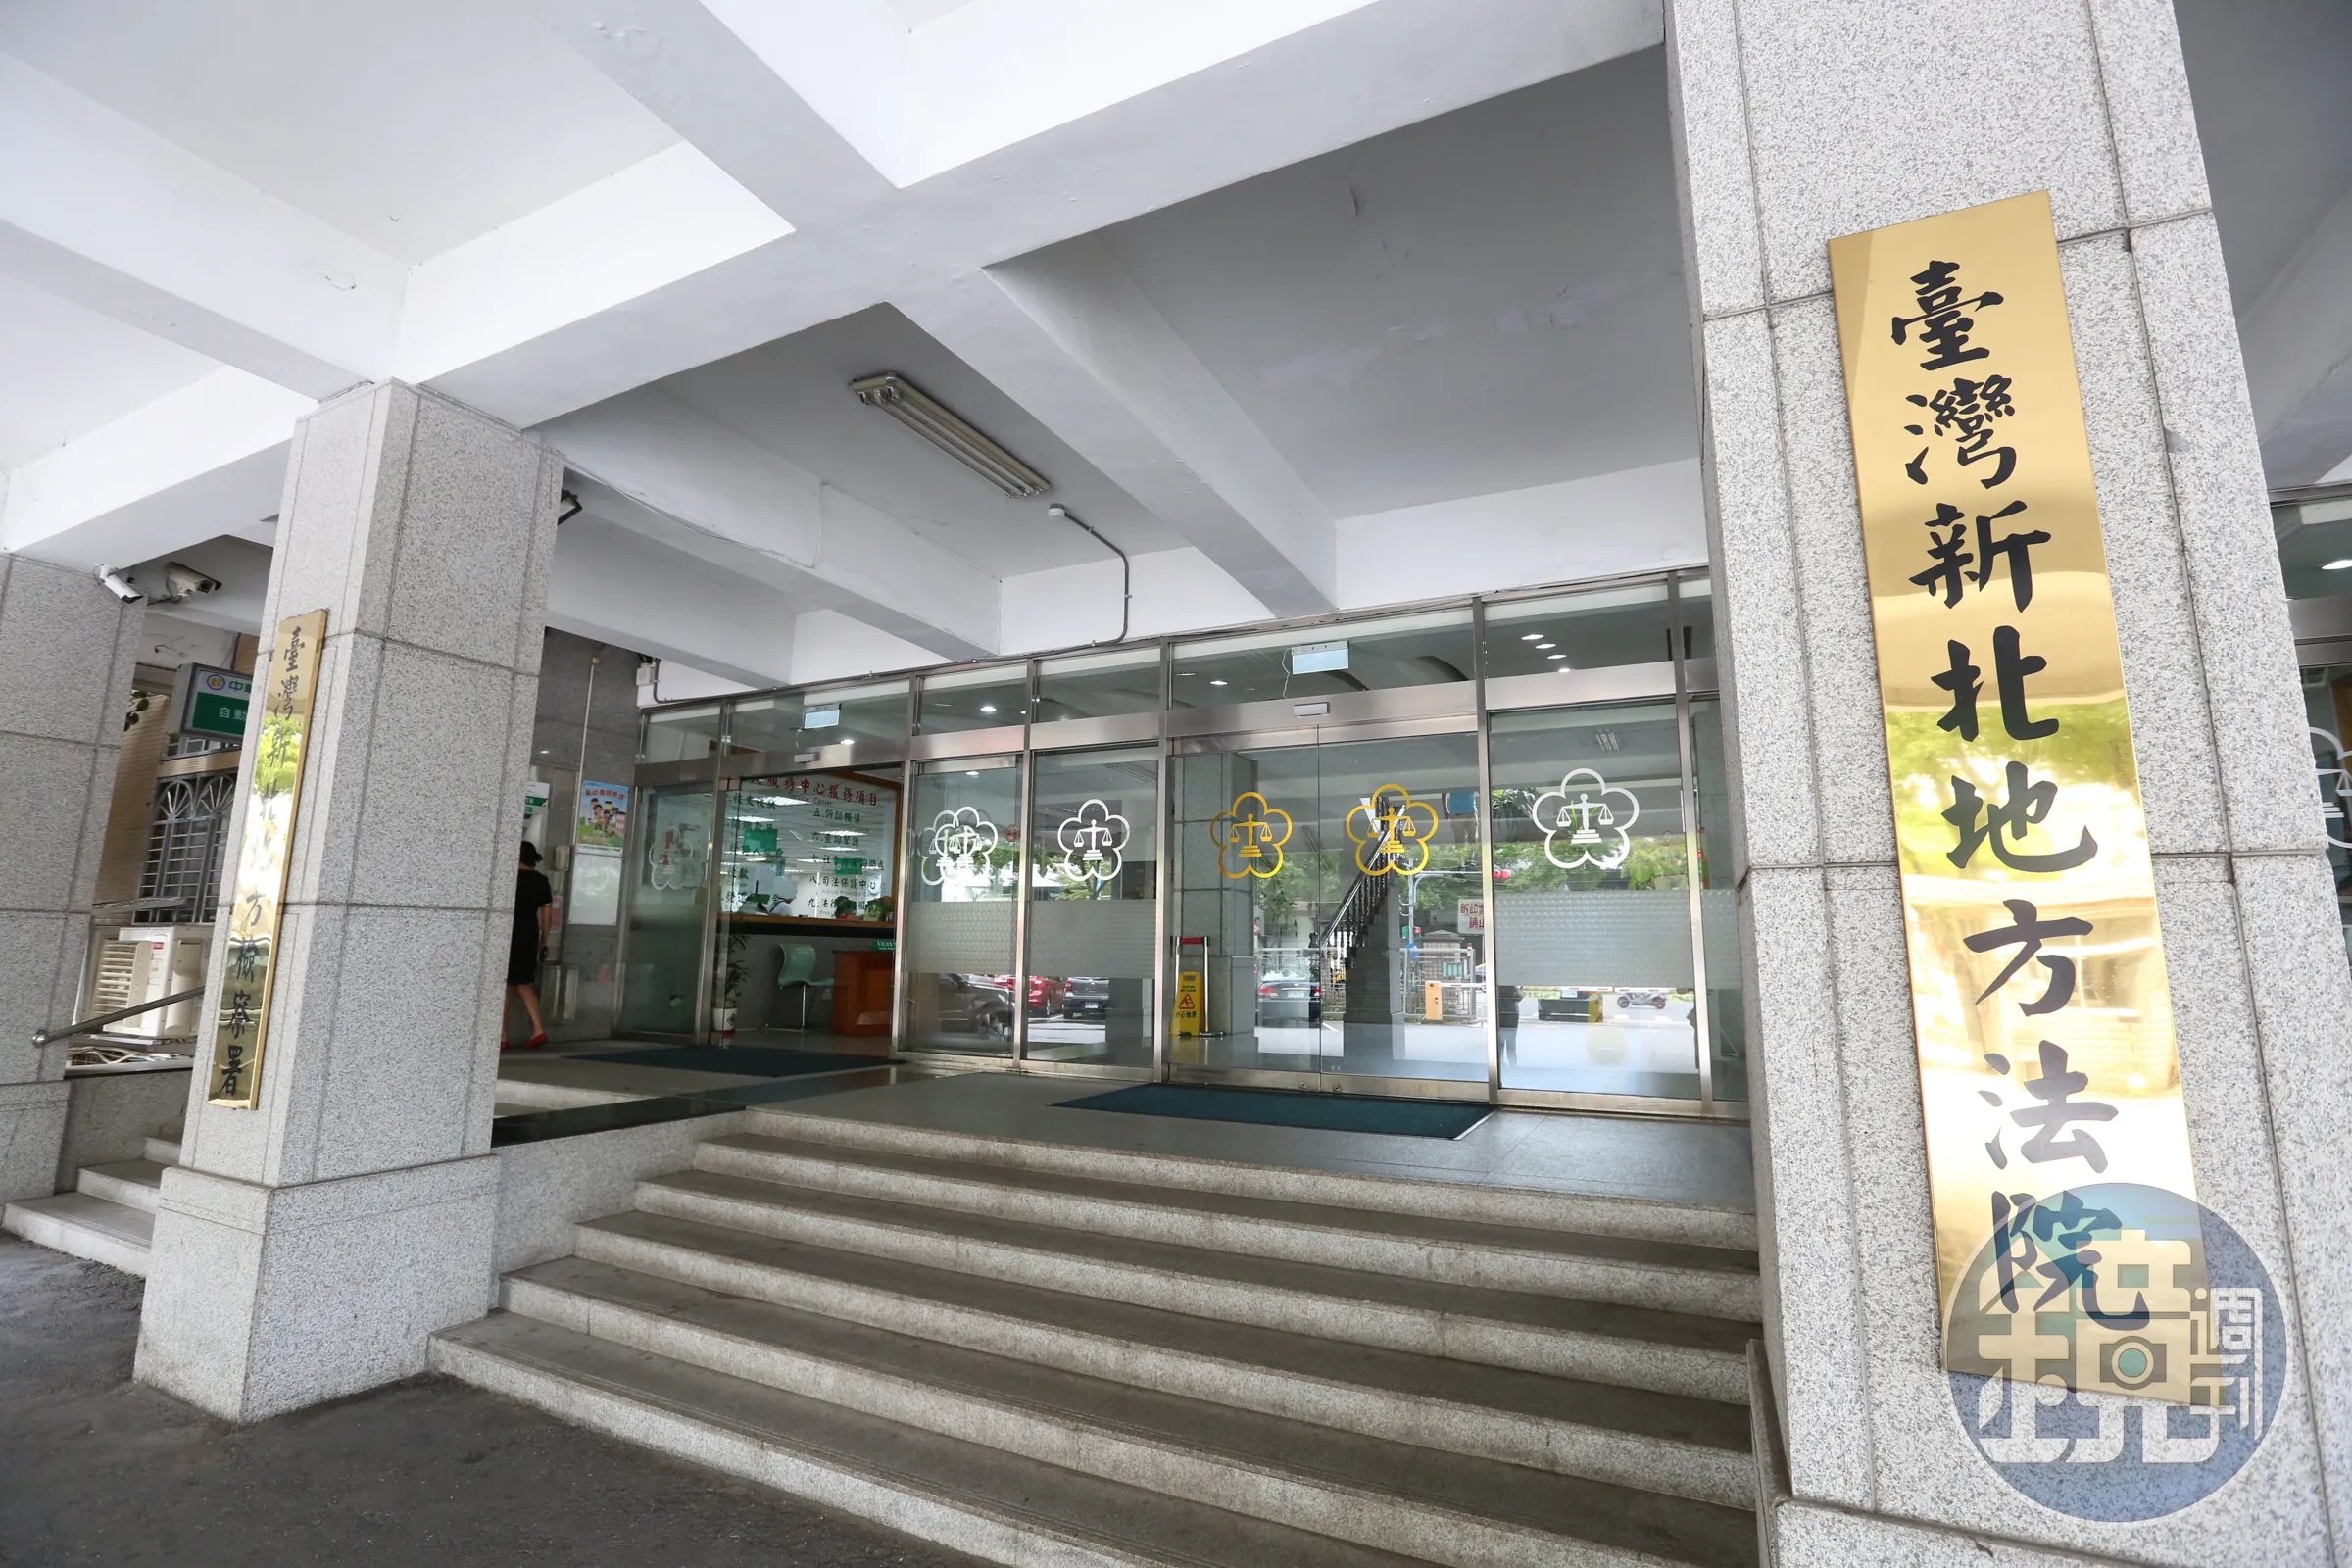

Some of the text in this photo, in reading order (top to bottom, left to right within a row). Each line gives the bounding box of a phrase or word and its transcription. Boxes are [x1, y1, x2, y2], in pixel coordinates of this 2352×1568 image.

[219, 625, 306, 1097] 臺灣新北地方檢察署
[1891, 260, 2150, 1331] 臺灣新北地方法院
